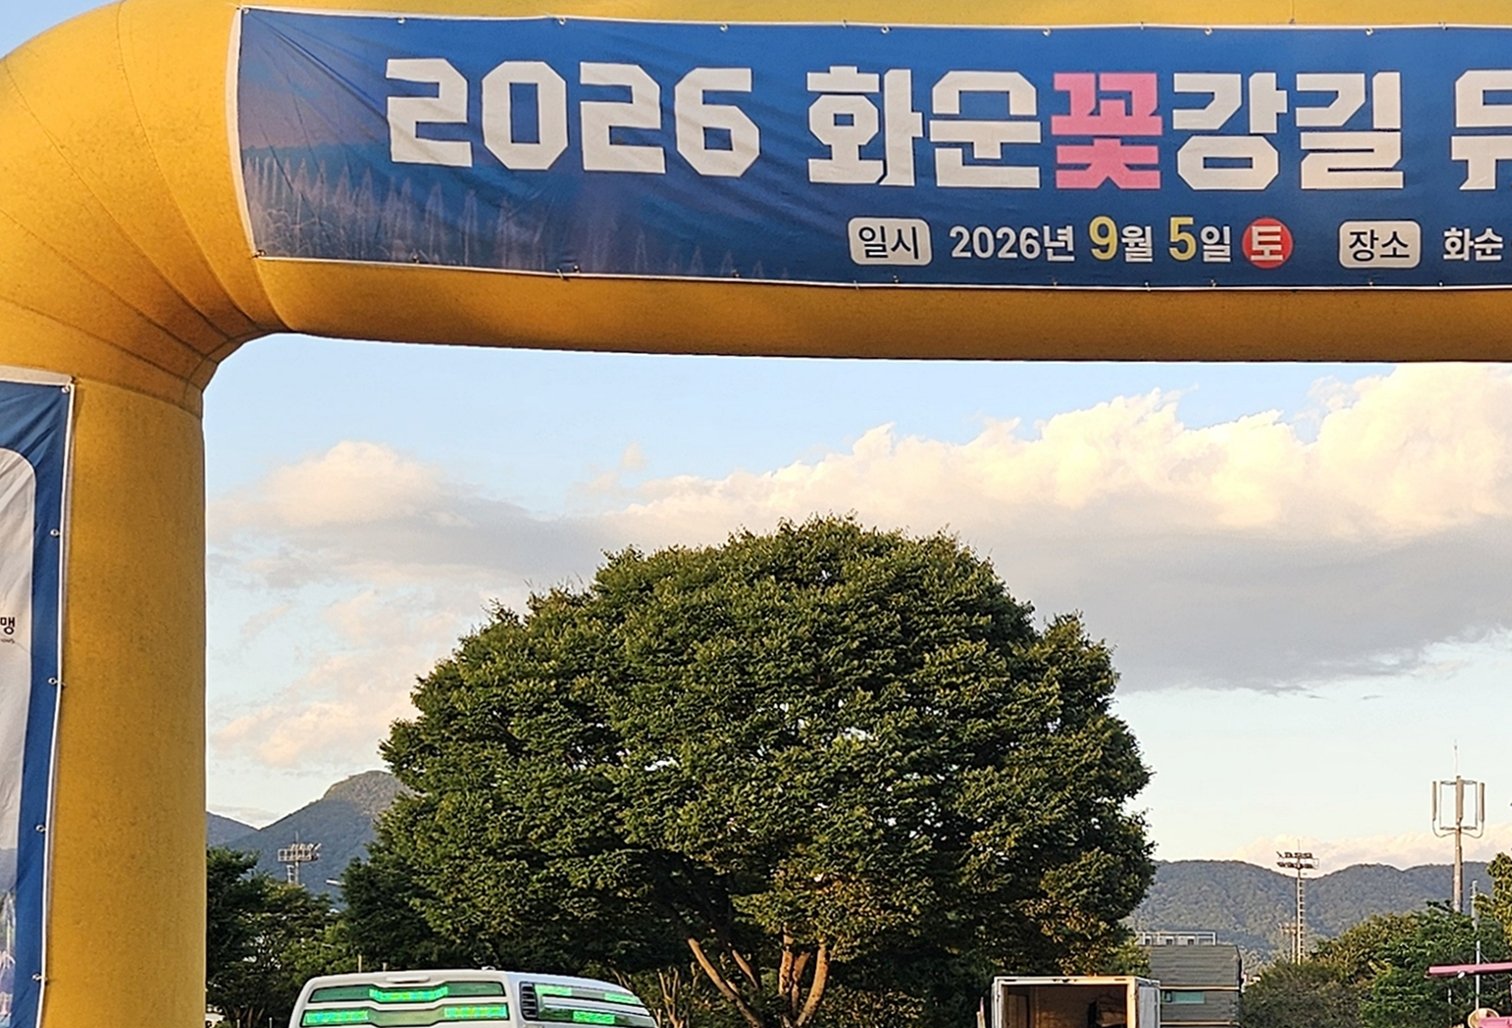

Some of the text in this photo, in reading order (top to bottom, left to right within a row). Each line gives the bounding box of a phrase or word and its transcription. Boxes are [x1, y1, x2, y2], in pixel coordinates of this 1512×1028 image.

[386, 58, 761, 177] 2026
[858, 225, 919, 260] 일시
[949, 224, 1076, 262] 2026년
[1088, 215, 1154, 263] 9월
[1169, 215, 1232, 264] 5일
[1250, 228, 1287, 262] 토
[1348, 229, 1412, 262] 장소
[1443, 225, 1504, 262] 화순
